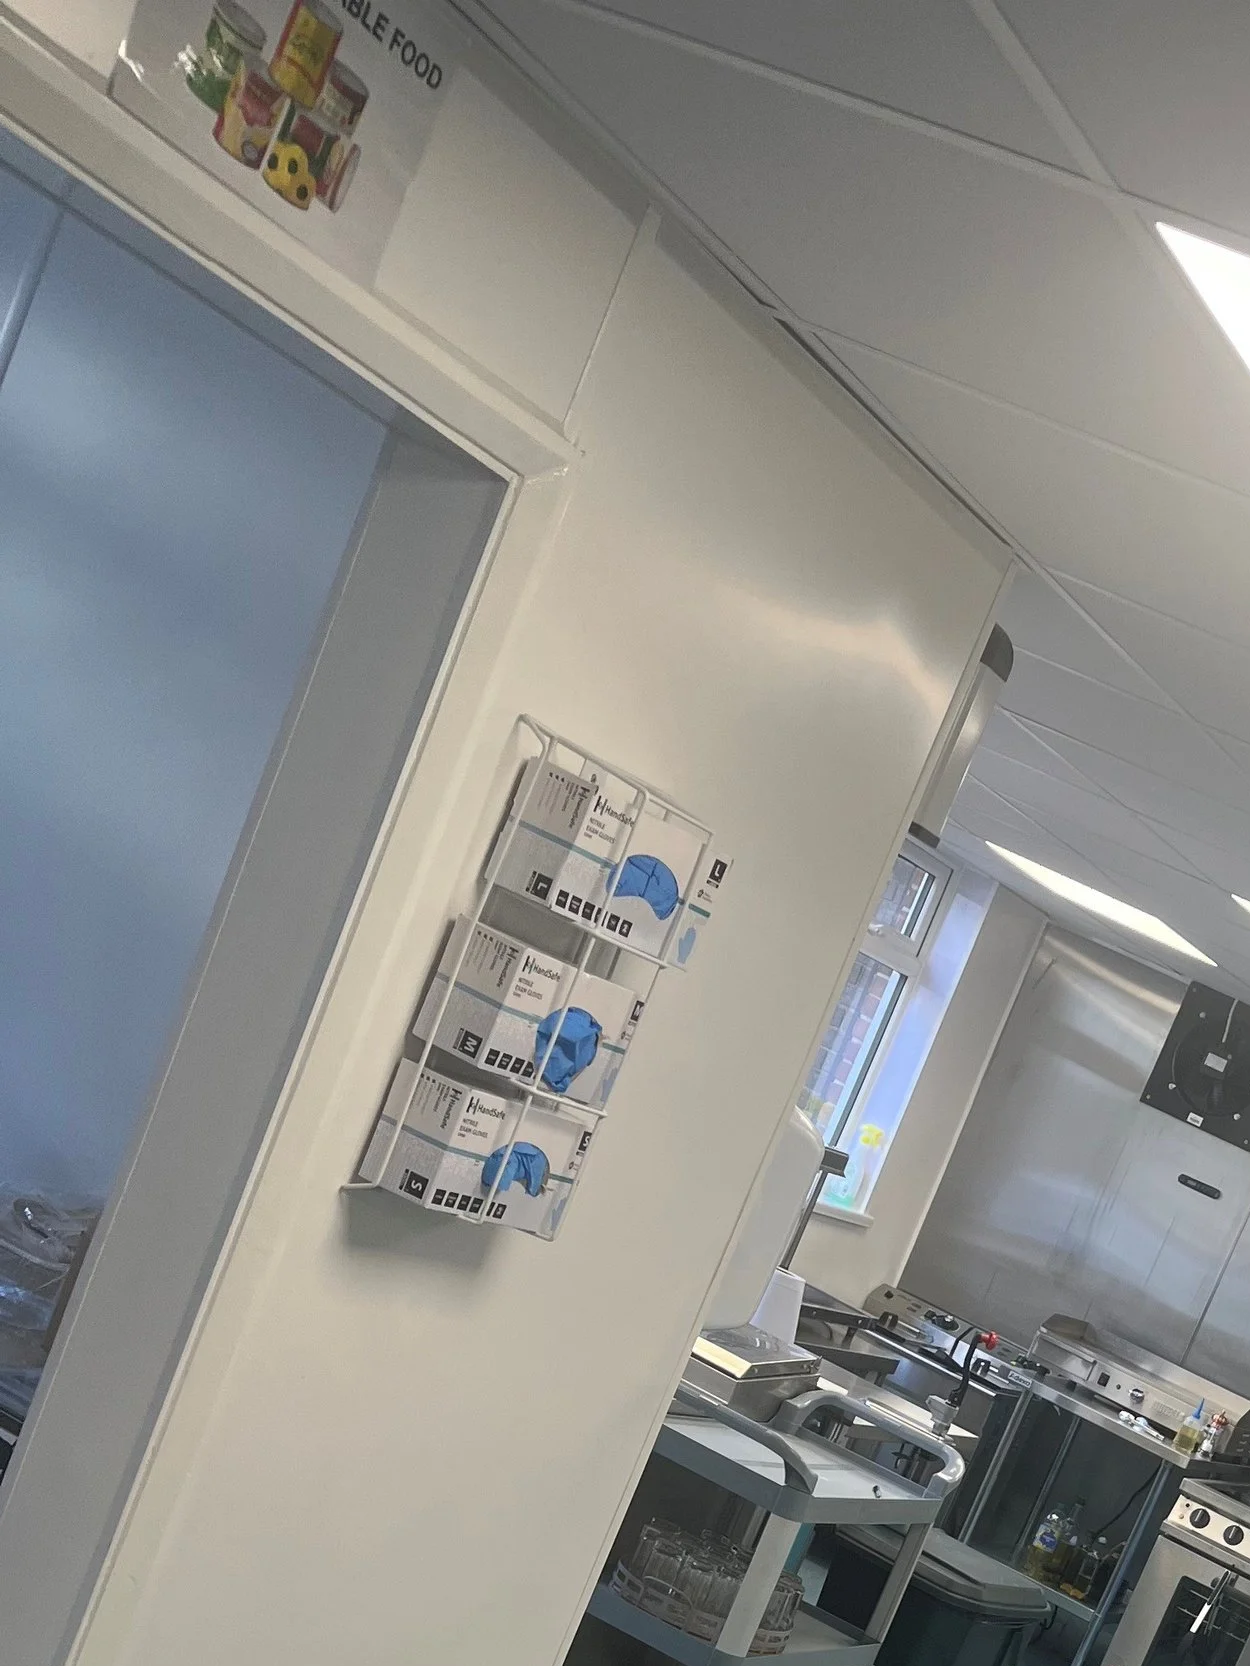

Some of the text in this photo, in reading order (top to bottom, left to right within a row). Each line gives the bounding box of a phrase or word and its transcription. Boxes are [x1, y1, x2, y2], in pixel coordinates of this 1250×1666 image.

[388, 26, 445, 91] FOOD
[604, 804, 634, 827] HandSafe
[533, 963, 560, 982] HandSafe
[463, 1036, 478, 1052] M
[477, 1103, 505, 1119] HandSafe
